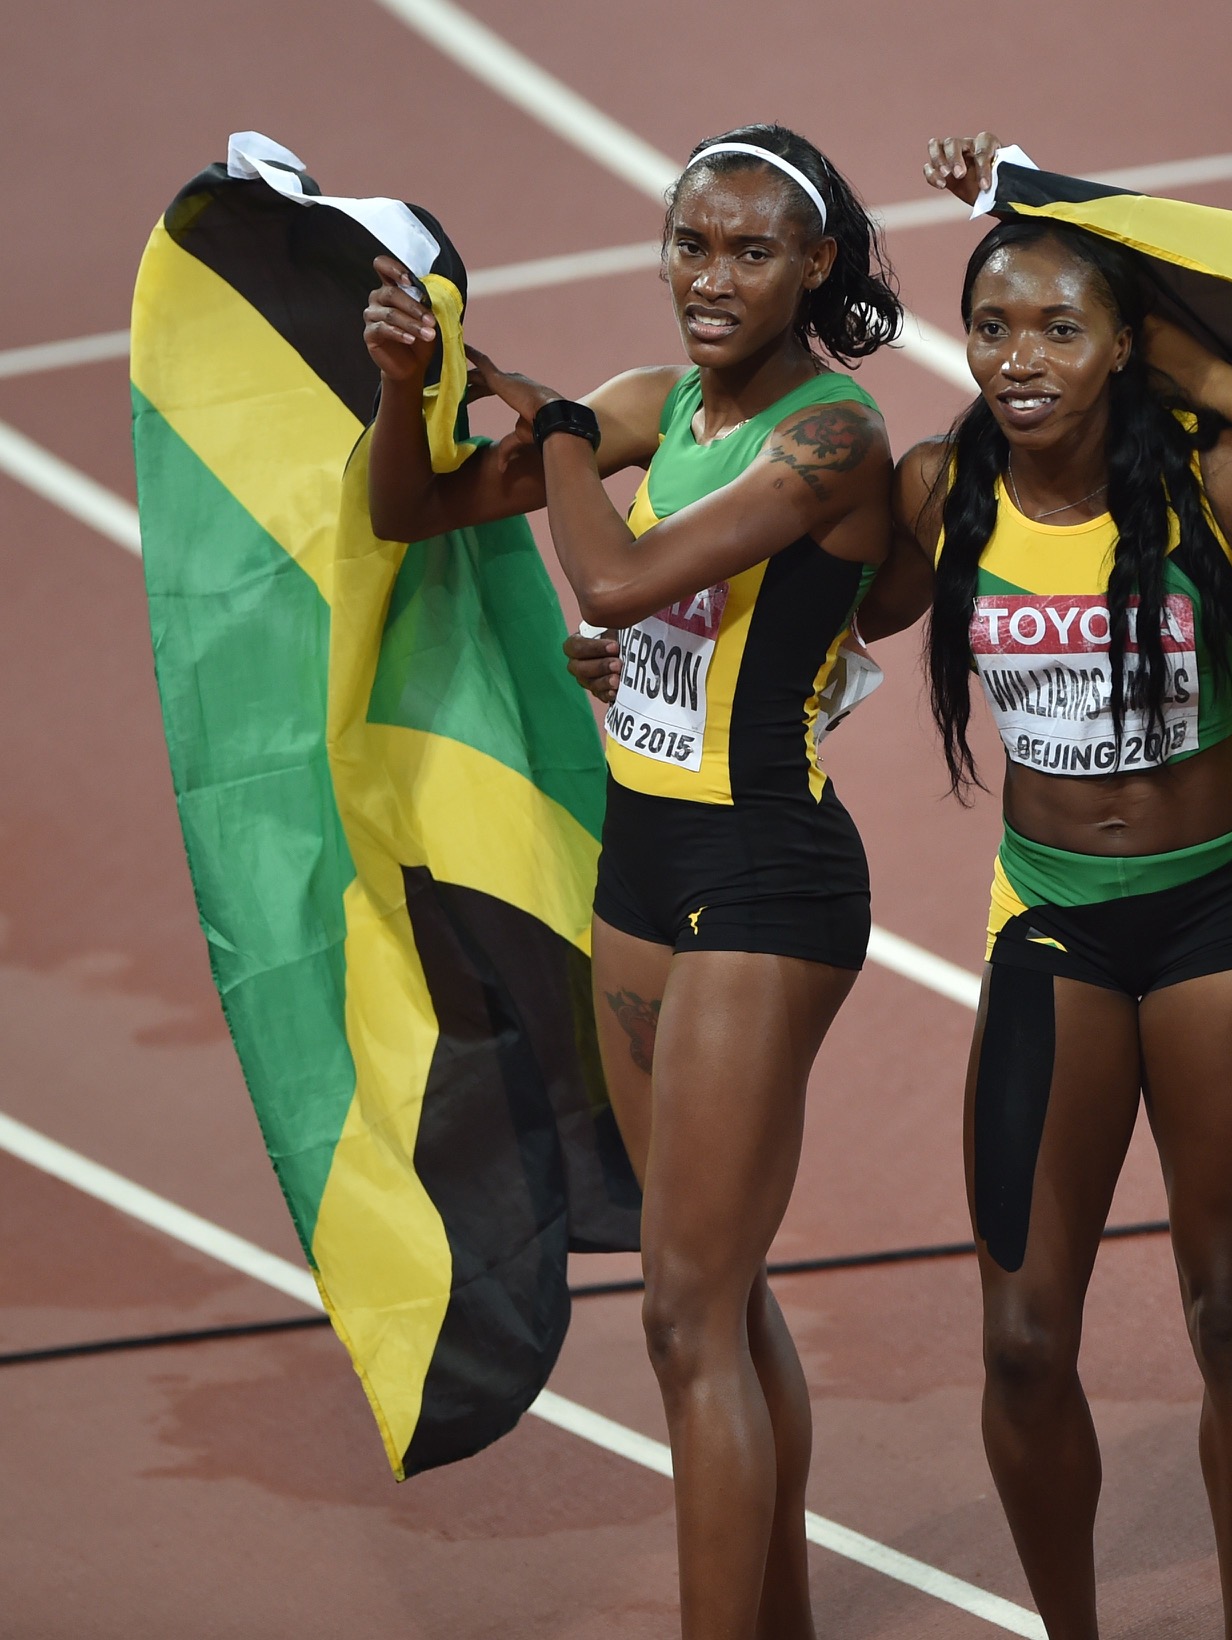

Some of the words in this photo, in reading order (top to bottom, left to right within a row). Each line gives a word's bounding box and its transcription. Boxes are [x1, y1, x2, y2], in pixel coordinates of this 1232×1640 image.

[618, 628, 702, 712] HERSON
[634, 722, 696, 762] 2015
[1016, 734, 1117, 771] BEIJING
[1124, 720, 1188, 767] 2015
